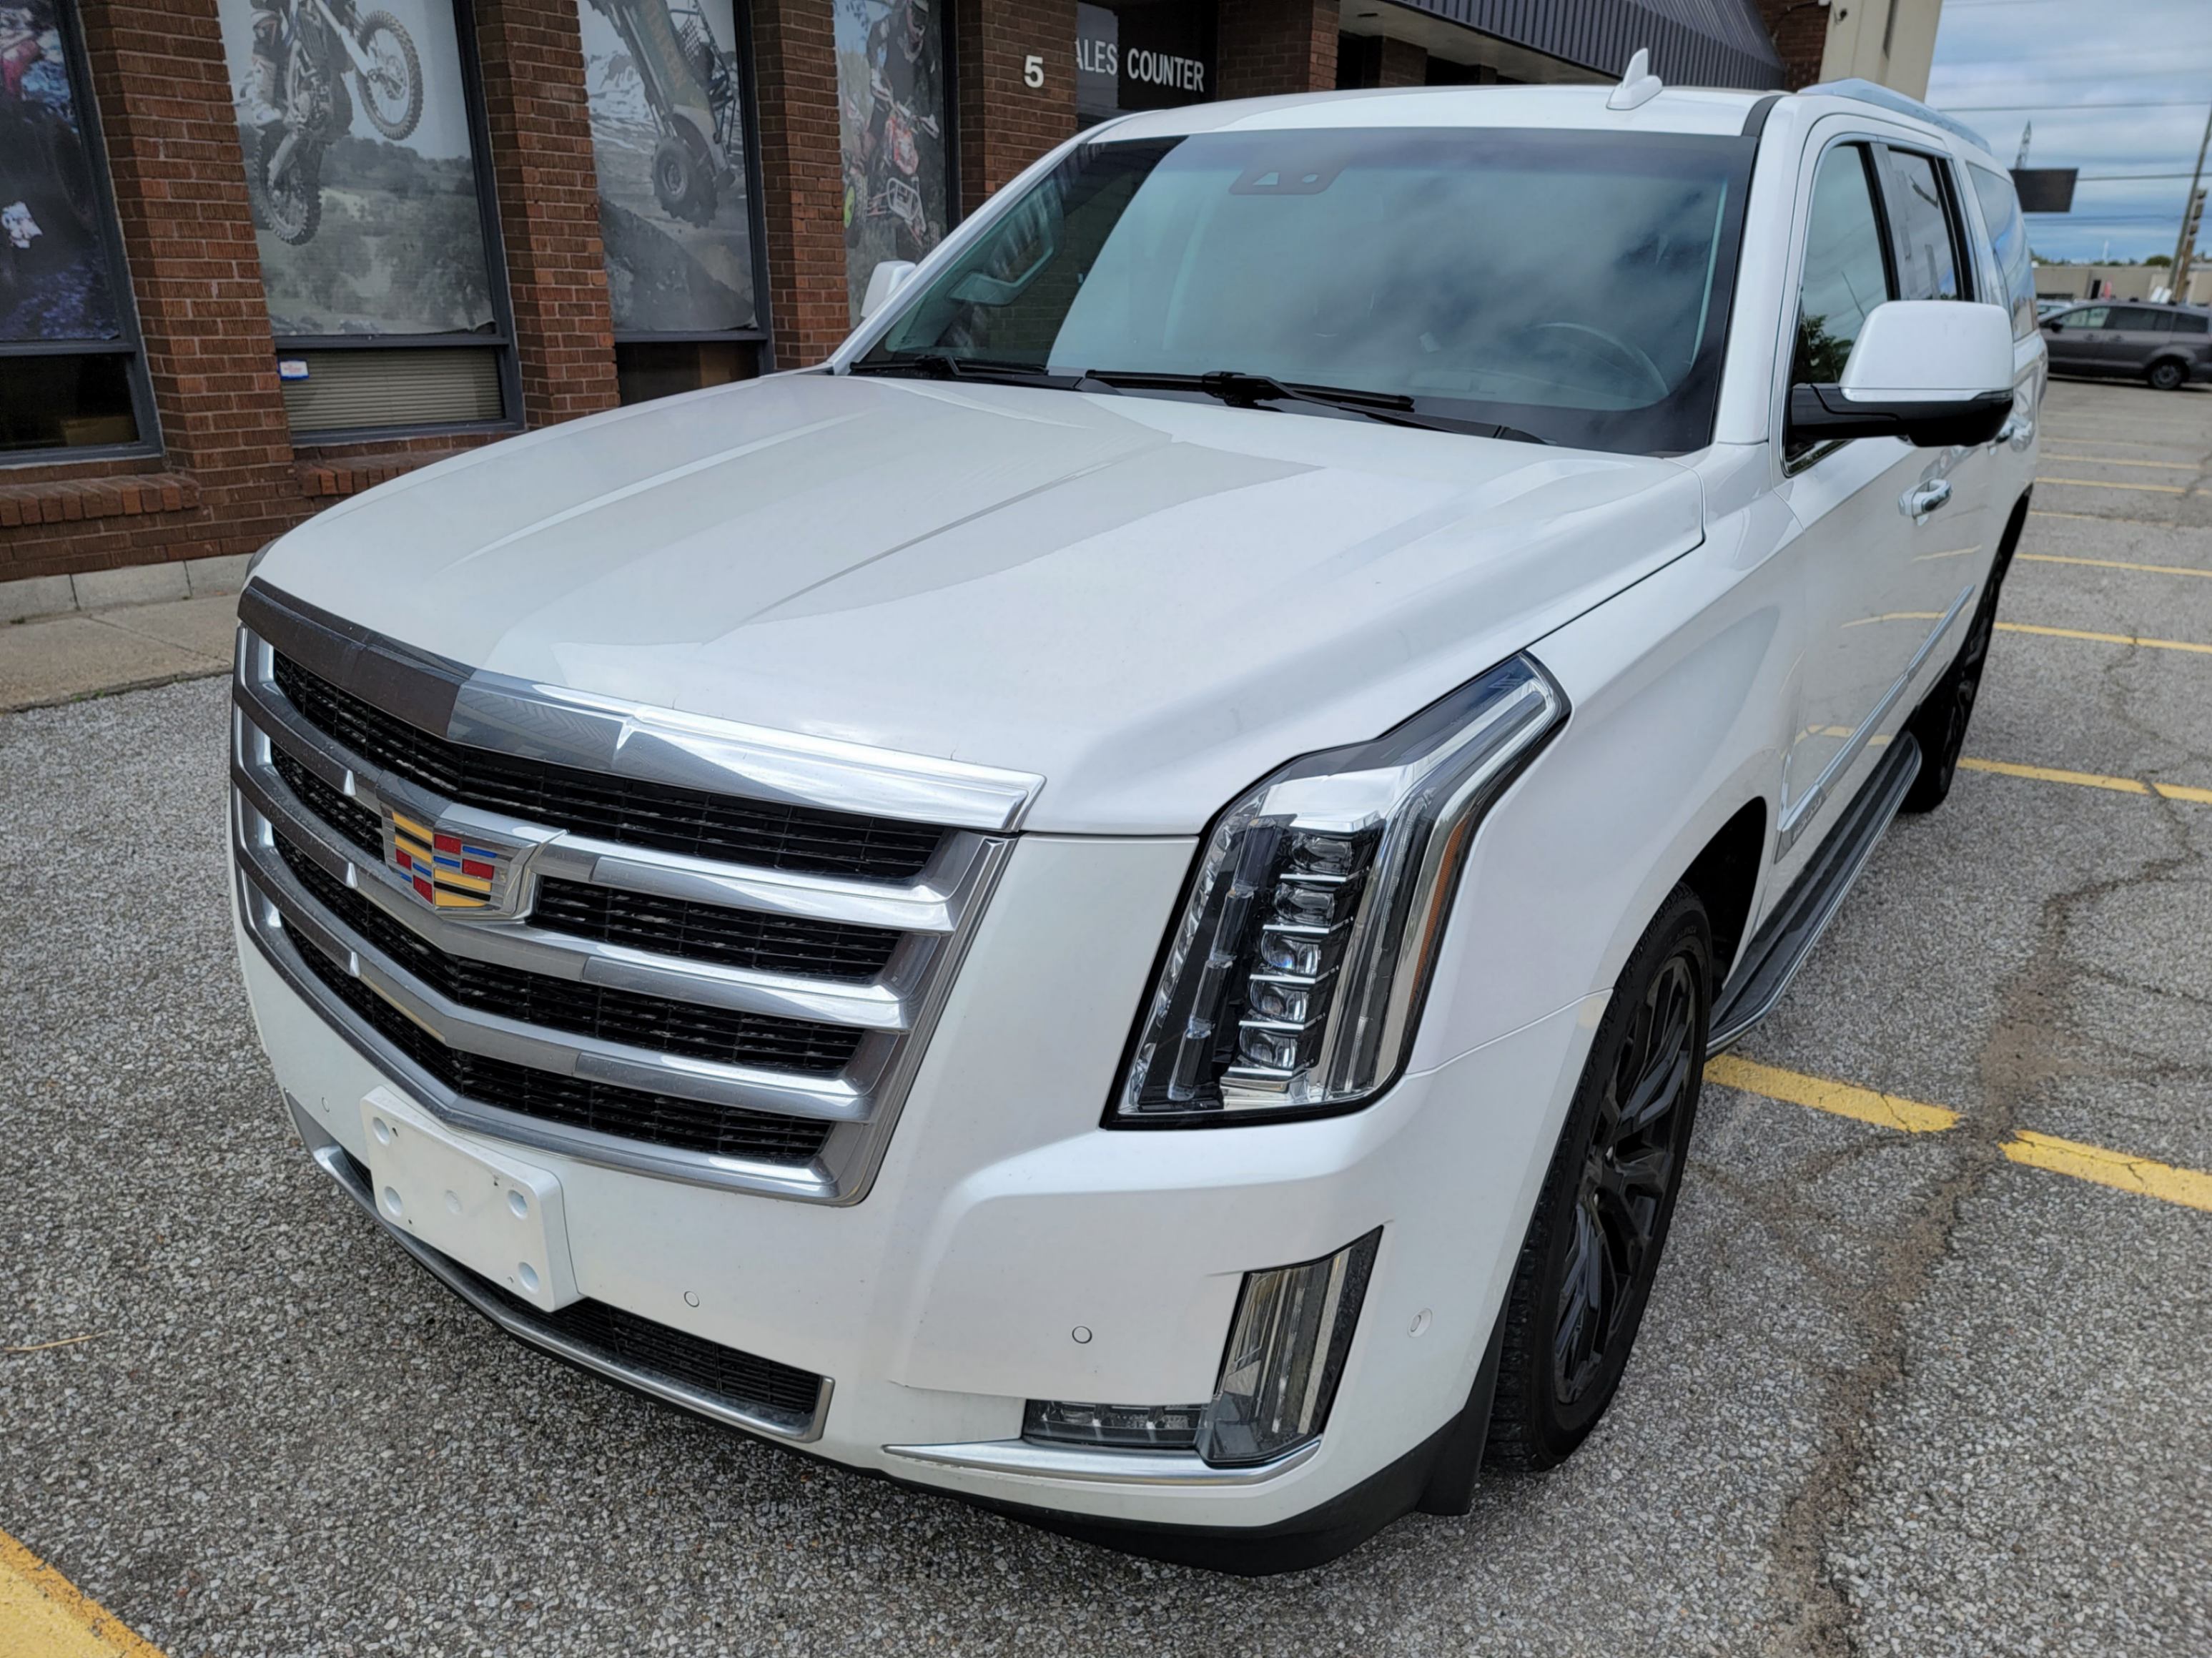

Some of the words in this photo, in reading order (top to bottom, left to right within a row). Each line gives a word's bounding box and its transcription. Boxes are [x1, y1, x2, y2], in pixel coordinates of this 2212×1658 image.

[1024, 54, 1044, 88] 5
[1075, 37, 1118, 75] ALES
[1127, 48, 1205, 92] COUNTER
